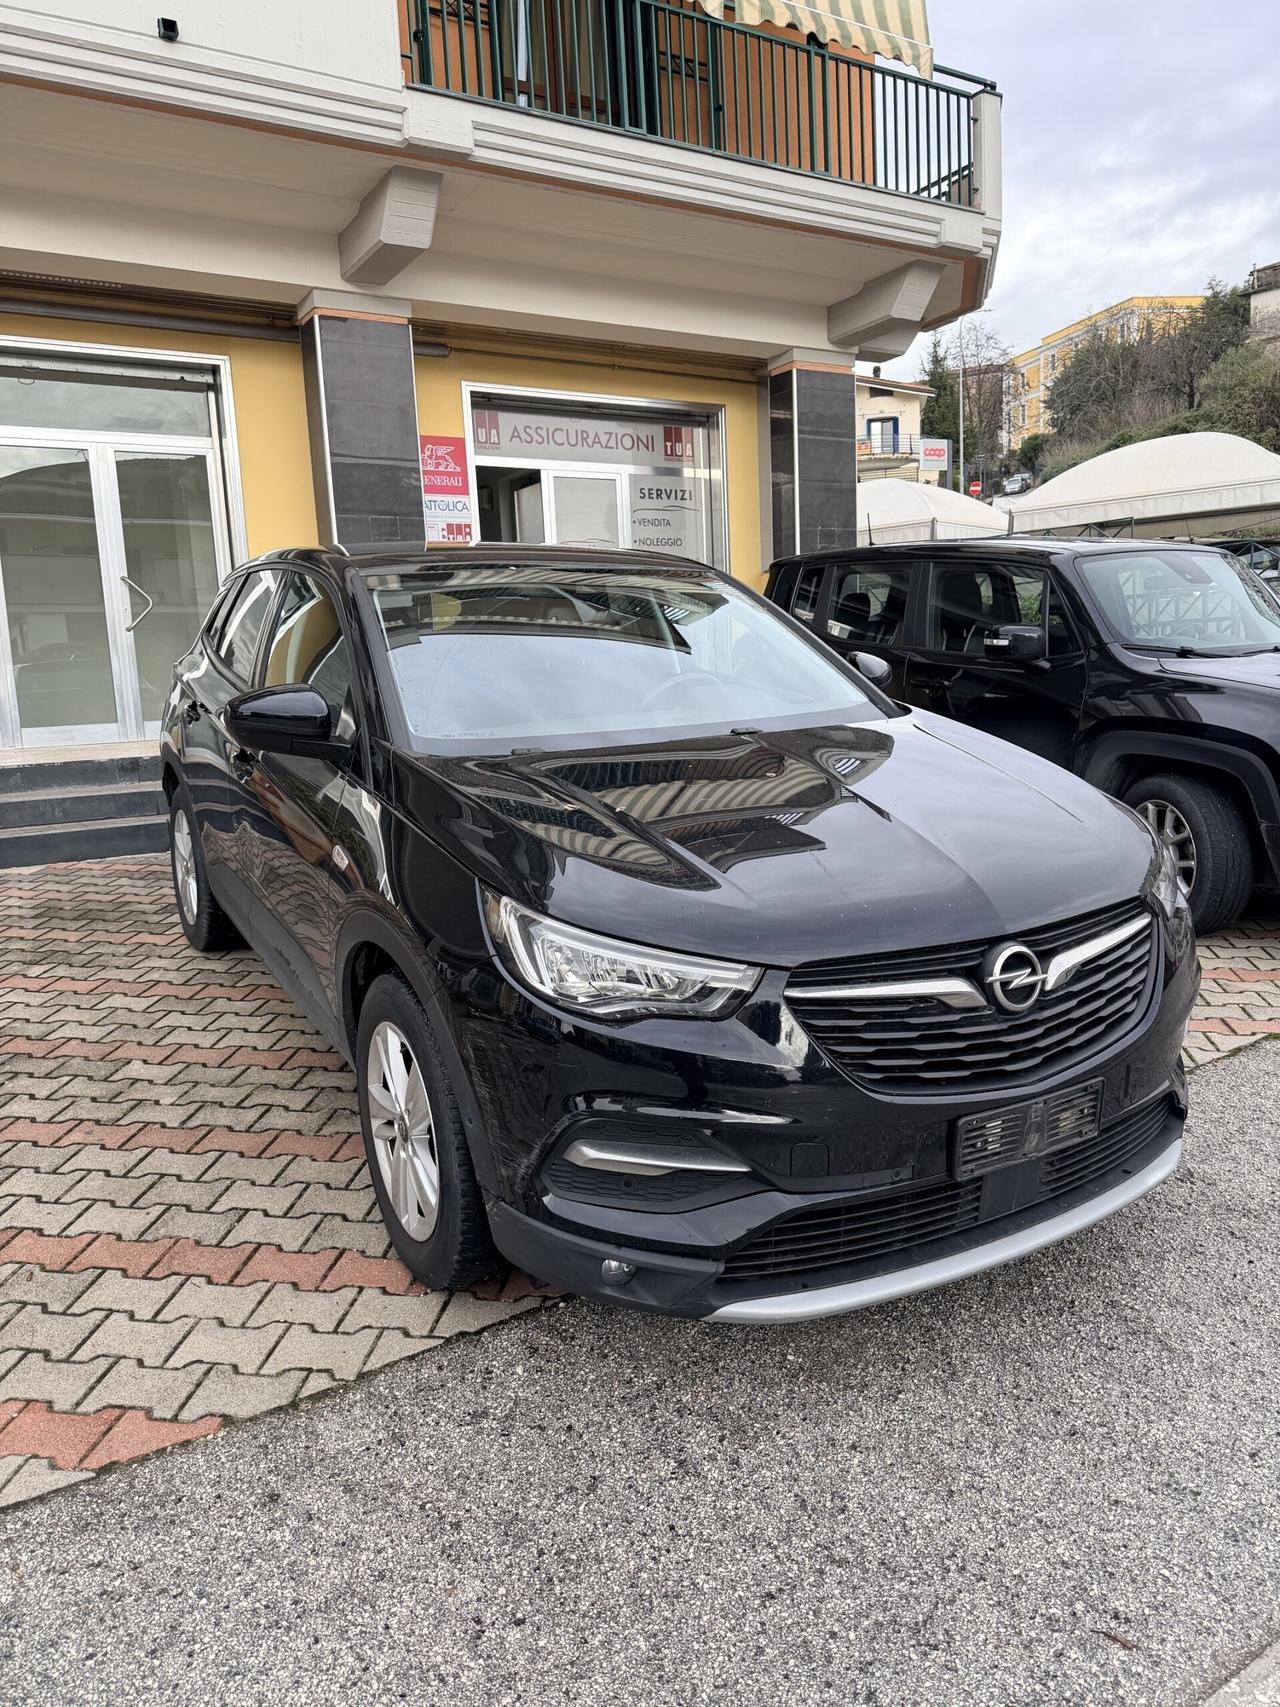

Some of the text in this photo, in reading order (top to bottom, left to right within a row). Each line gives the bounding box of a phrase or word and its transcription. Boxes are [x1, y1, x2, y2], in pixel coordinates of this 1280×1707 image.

[509, 424, 655, 453] ASSICURAZIONI
[665, 441, 693, 456] TUA
[924, 448, 946, 458] coop
[639, 487, 693, 501] SERVIZI
[637, 518, 672, 528] VENDITA
[638, 537, 683, 547] NOLEGGIO
